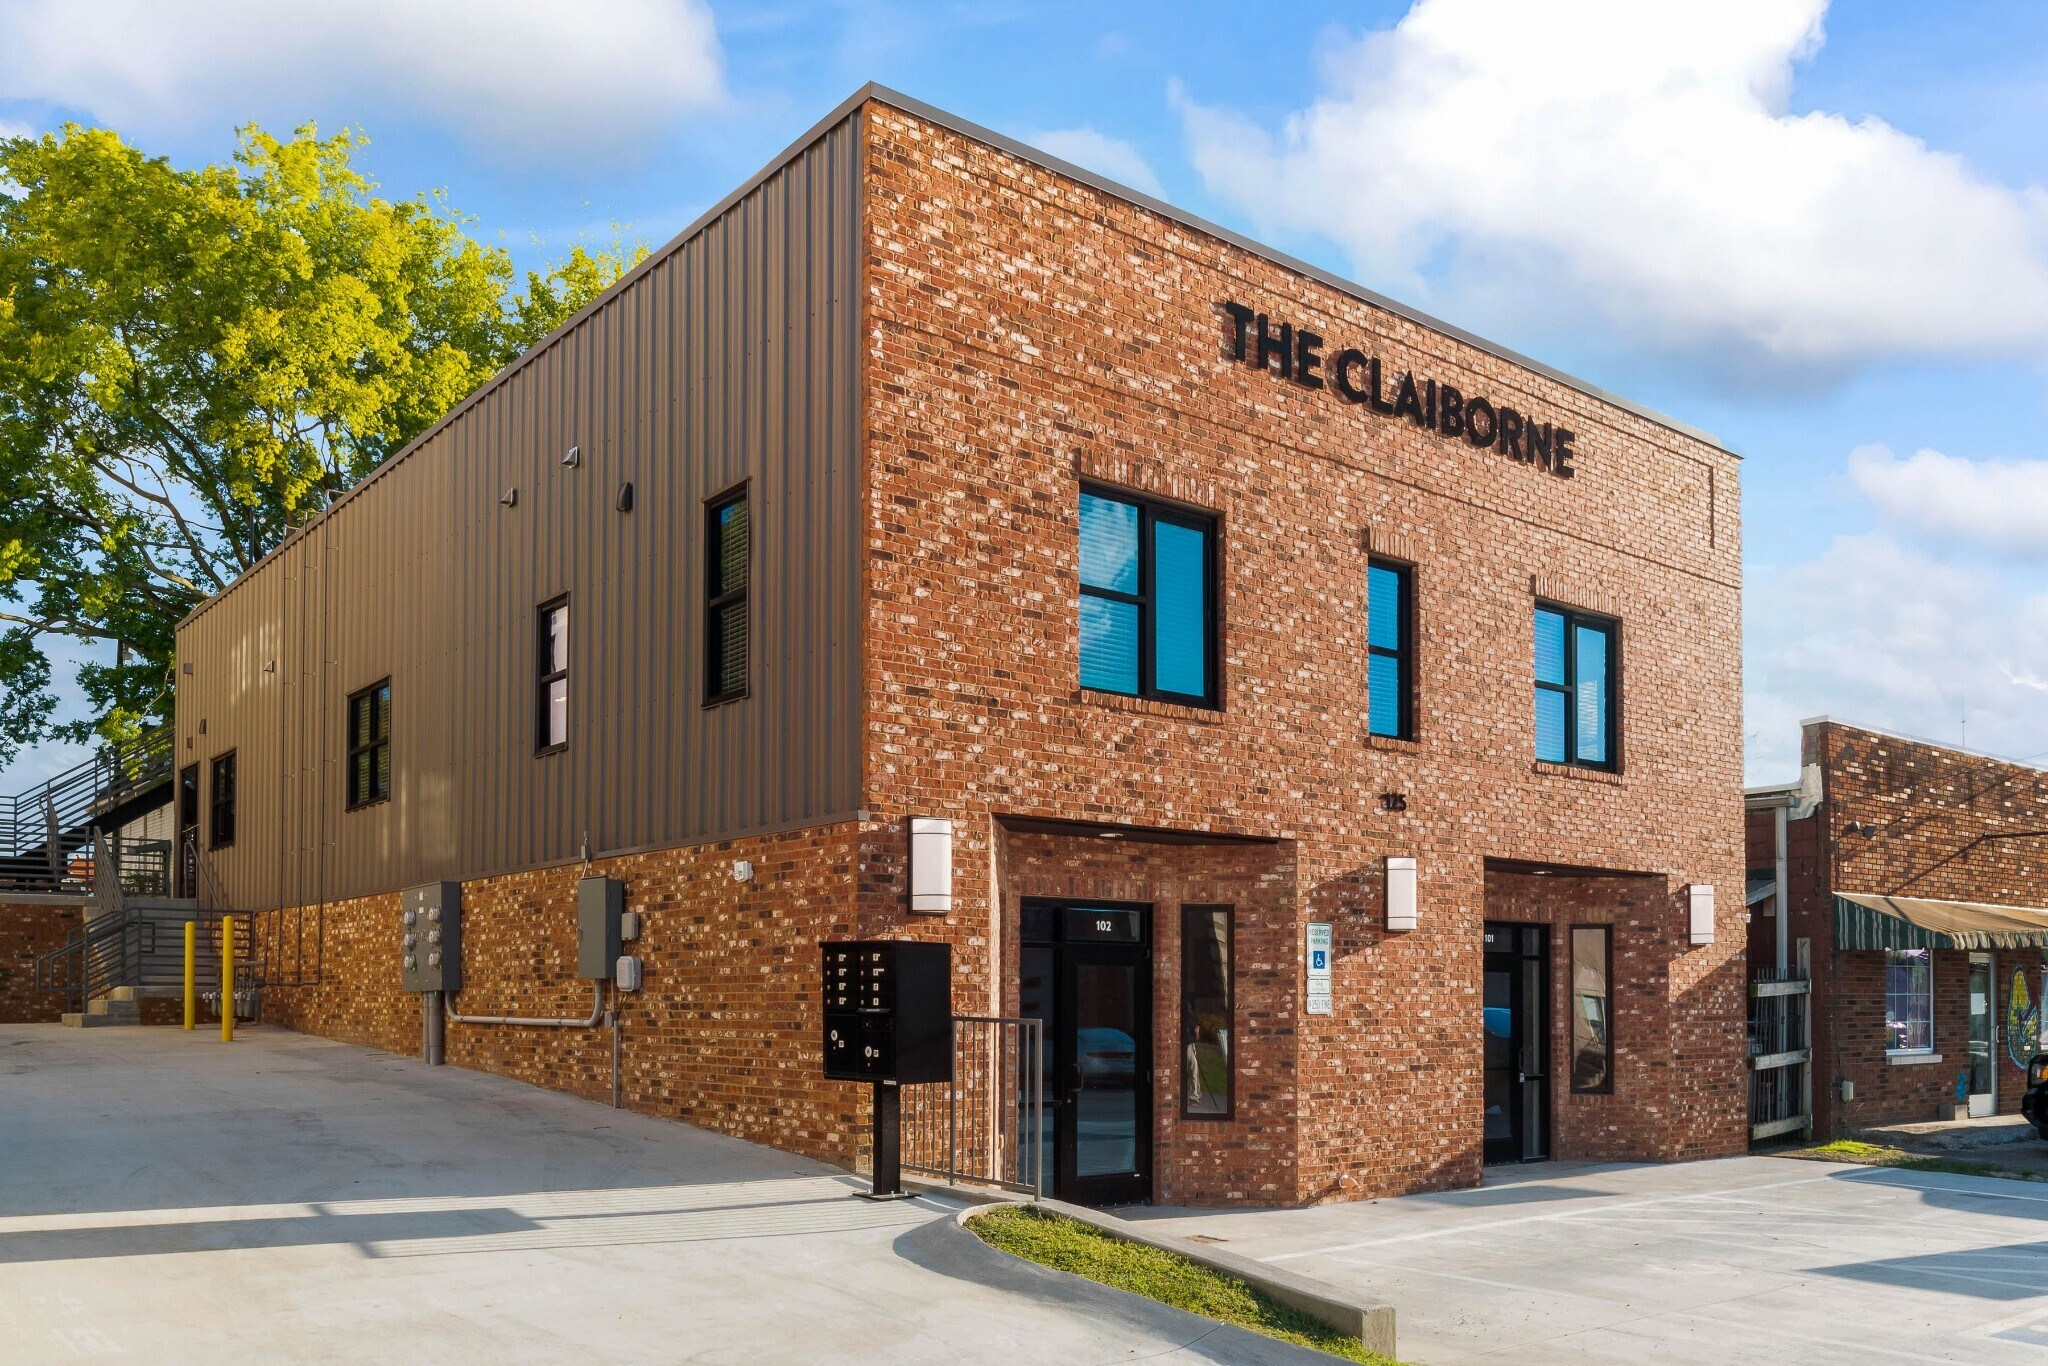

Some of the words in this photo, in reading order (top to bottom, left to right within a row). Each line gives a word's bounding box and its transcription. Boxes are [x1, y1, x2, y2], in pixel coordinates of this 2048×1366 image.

[1226, 301, 1324, 389] THE
[1337, 348, 1575, 479] CLAIBORNE
[1096, 920, 1112, 931] 102
[1309, 928, 1330, 937] RESERVED
[1310, 937, 1329, 946] PARKING
[1485, 934, 1494, 943] 101
[1308, 999, 1320, 1010] $250
[1321, 999, 1331, 1010] FINE
